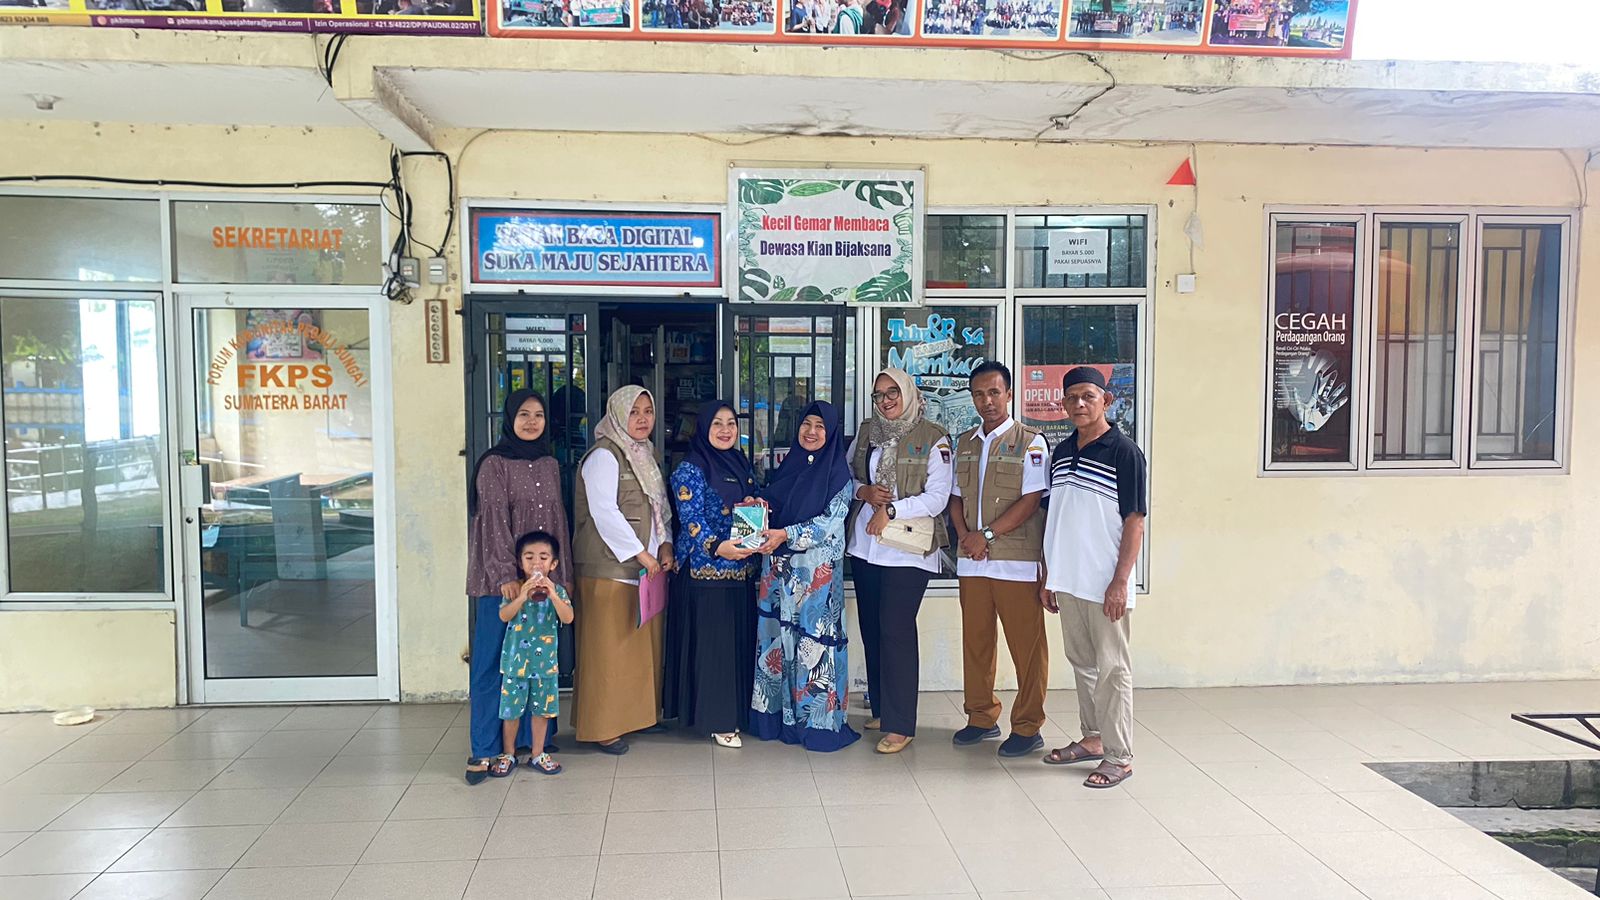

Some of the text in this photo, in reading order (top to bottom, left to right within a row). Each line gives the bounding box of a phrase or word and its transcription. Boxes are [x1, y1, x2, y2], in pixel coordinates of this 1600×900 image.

[314, 19, 327, 27] Izin
[329, 20, 370, 29] Operasional
[762, 214, 890, 232] Kecil Gemar Membaca
[212, 226, 343, 250] SEKRETARIAT
[567, 225, 617, 247] BACA
[621, 226, 694, 247] DIGITAL
[1068, 238, 1088, 246] WIFI
[760, 240, 891, 258] Dewasa Kian Bijaksana
[483, 252, 709, 273] SUKA MAJU SEJAHTERA
[1275, 312, 1346, 331] CEGAH
[1276, 330, 1346, 345] Perdagangan Orang
[207, 349, 235, 386] FORUM
[334, 344, 368, 388] SUNGAI
[237, 364, 334, 389] FKPS
[915, 376, 970, 388] Bacaan Masyar
[224, 394, 348, 410] SUMATERA BARAT
[1024, 388, 1051, 402] OPEN
